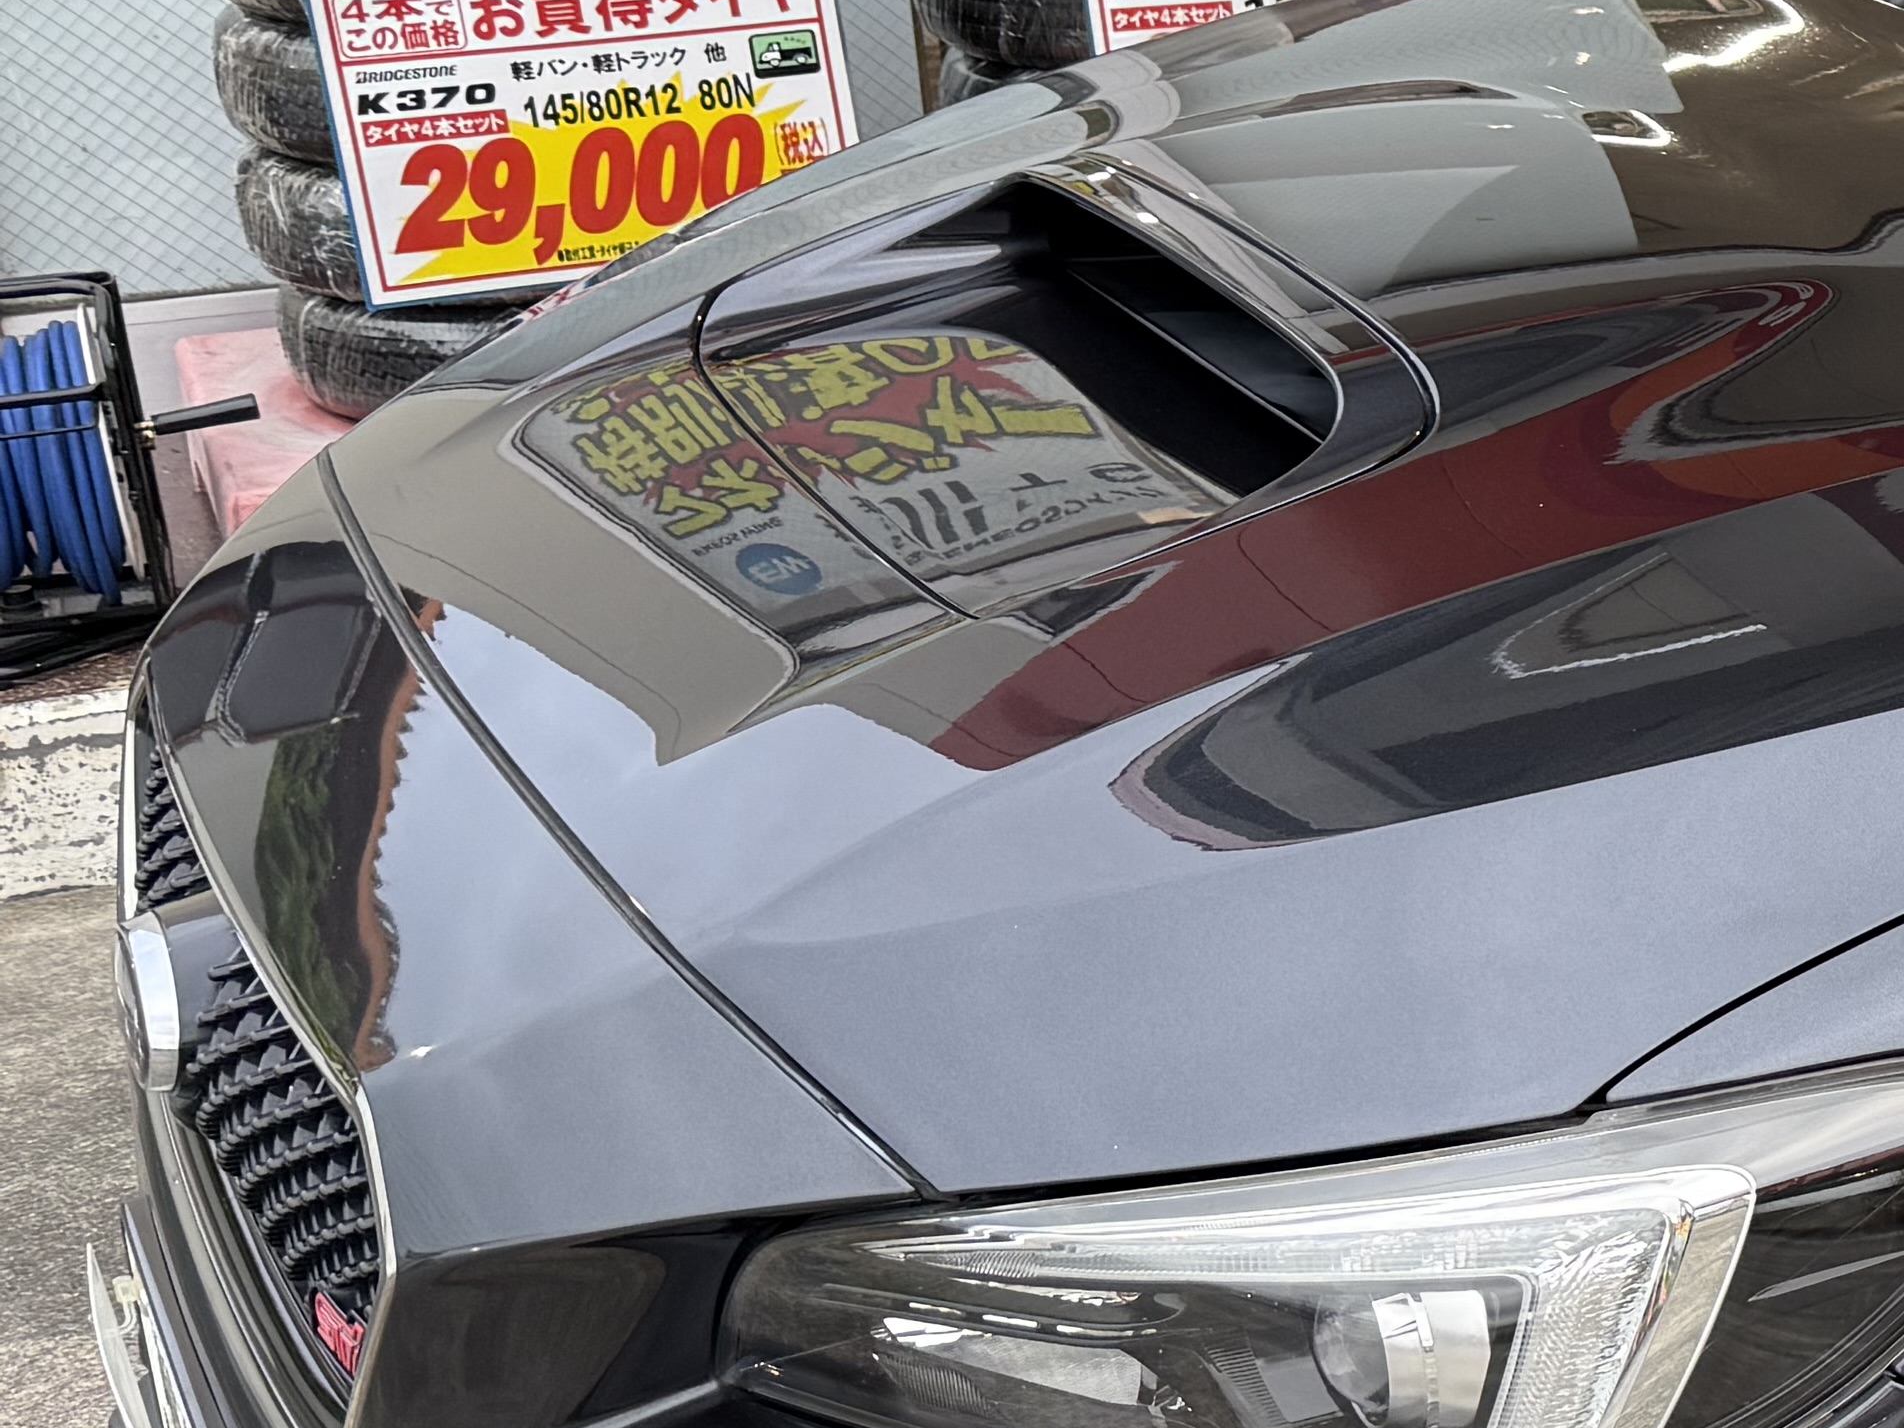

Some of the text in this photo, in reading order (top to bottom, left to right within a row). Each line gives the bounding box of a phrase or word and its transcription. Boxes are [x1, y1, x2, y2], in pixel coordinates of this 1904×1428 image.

[345, 19, 461, 52] この価格
[355, 64, 457, 84] BRIDGESTONE
[512, 42, 727, 82] 軽バン・軽トラック 他
[357, 83, 497, 116] K370
[525, 72, 756, 128] 145/80R12 80N
[365, 114, 506, 146] タイヤ4本セット
[395, 113, 765, 265] 29,000
